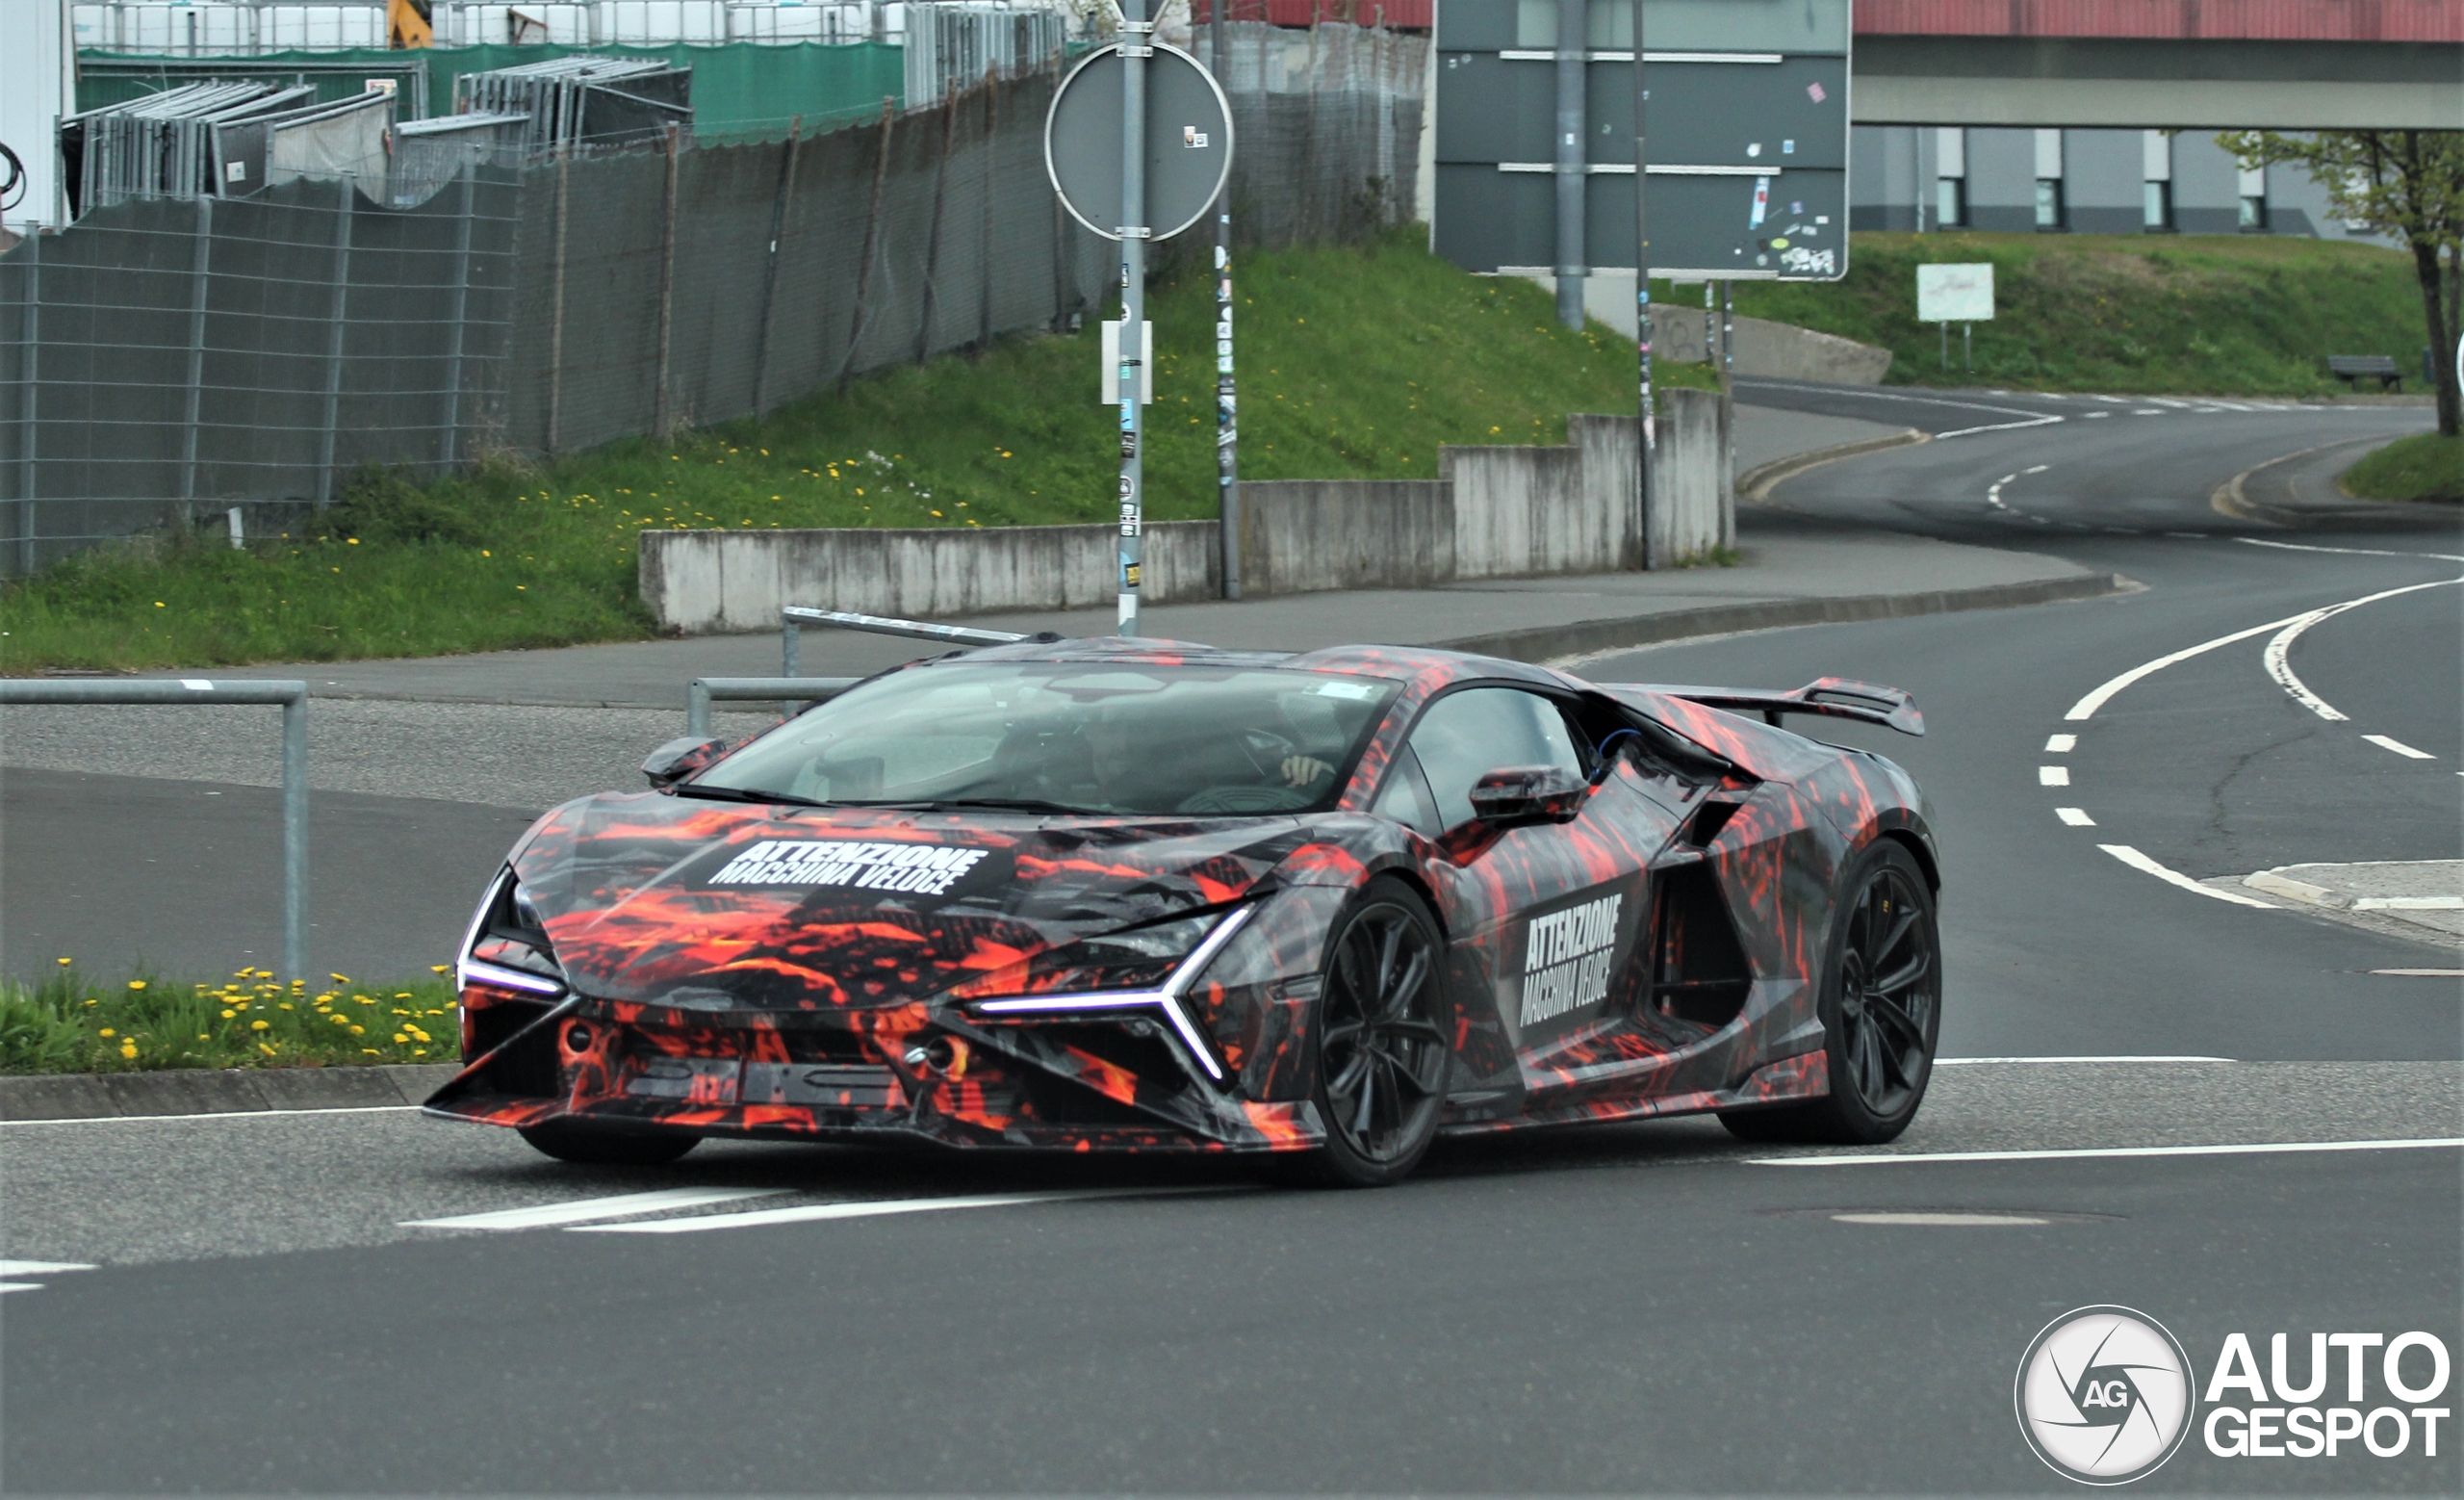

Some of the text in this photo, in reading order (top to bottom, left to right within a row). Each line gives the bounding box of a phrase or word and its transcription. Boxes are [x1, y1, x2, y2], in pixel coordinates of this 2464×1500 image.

[707, 861, 965, 895] MACCHINA VELOCE
[732, 841, 988, 871] ATTENZIONE
[1525, 892, 1623, 972] ATTENZIONE
[1520, 946, 1614, 1027] MACCHINA VELOCE
